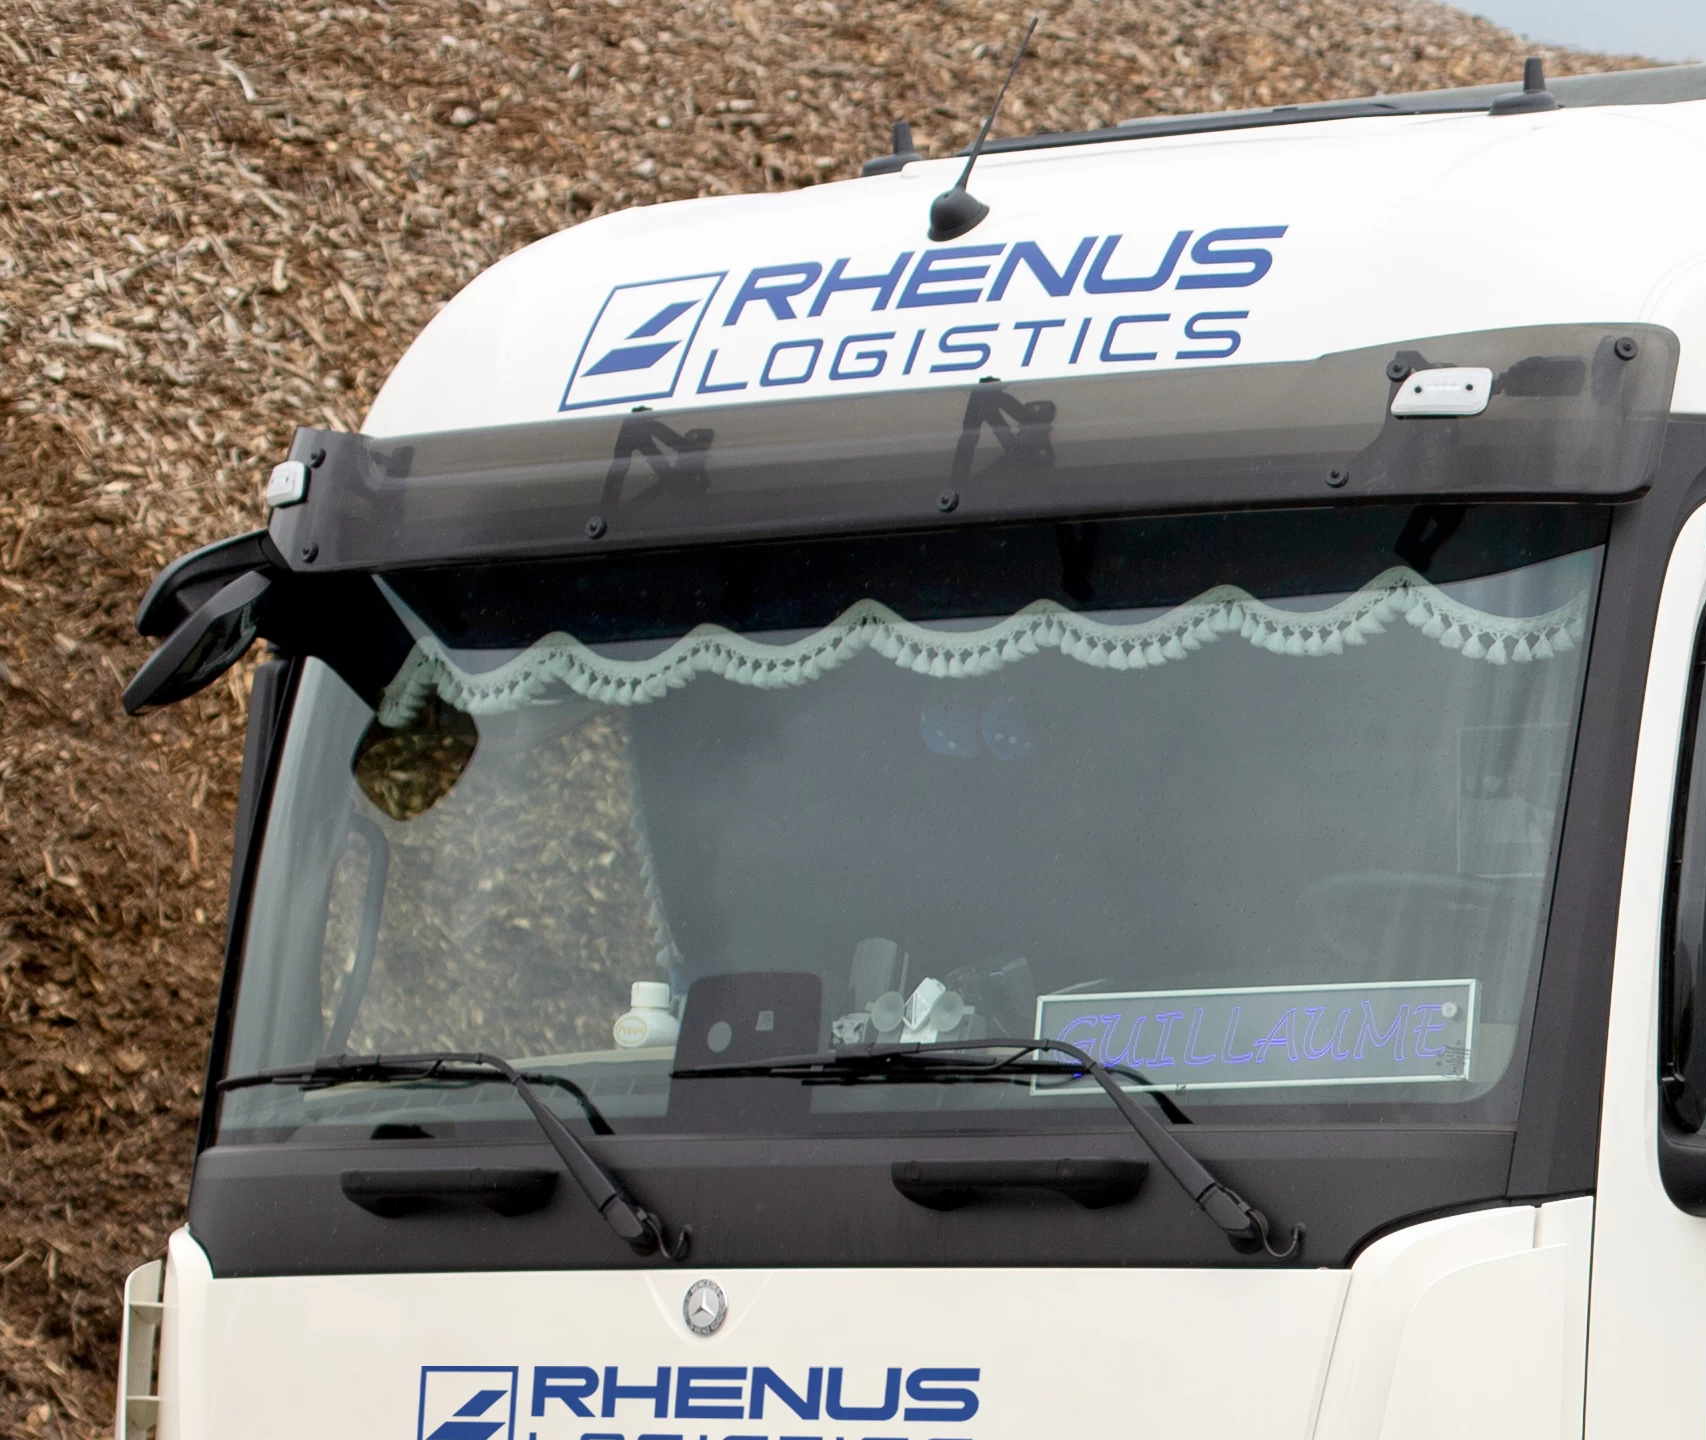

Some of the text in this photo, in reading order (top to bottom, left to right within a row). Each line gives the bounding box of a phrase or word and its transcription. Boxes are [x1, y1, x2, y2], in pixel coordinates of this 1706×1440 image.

[722, 224, 1290, 327] RHENUS
[695, 310, 1250, 395] LOGISTICS
[1053, 1000, 1448, 1070] GUILLAUME
[531, 1365, 980, 1421] RHENUS
